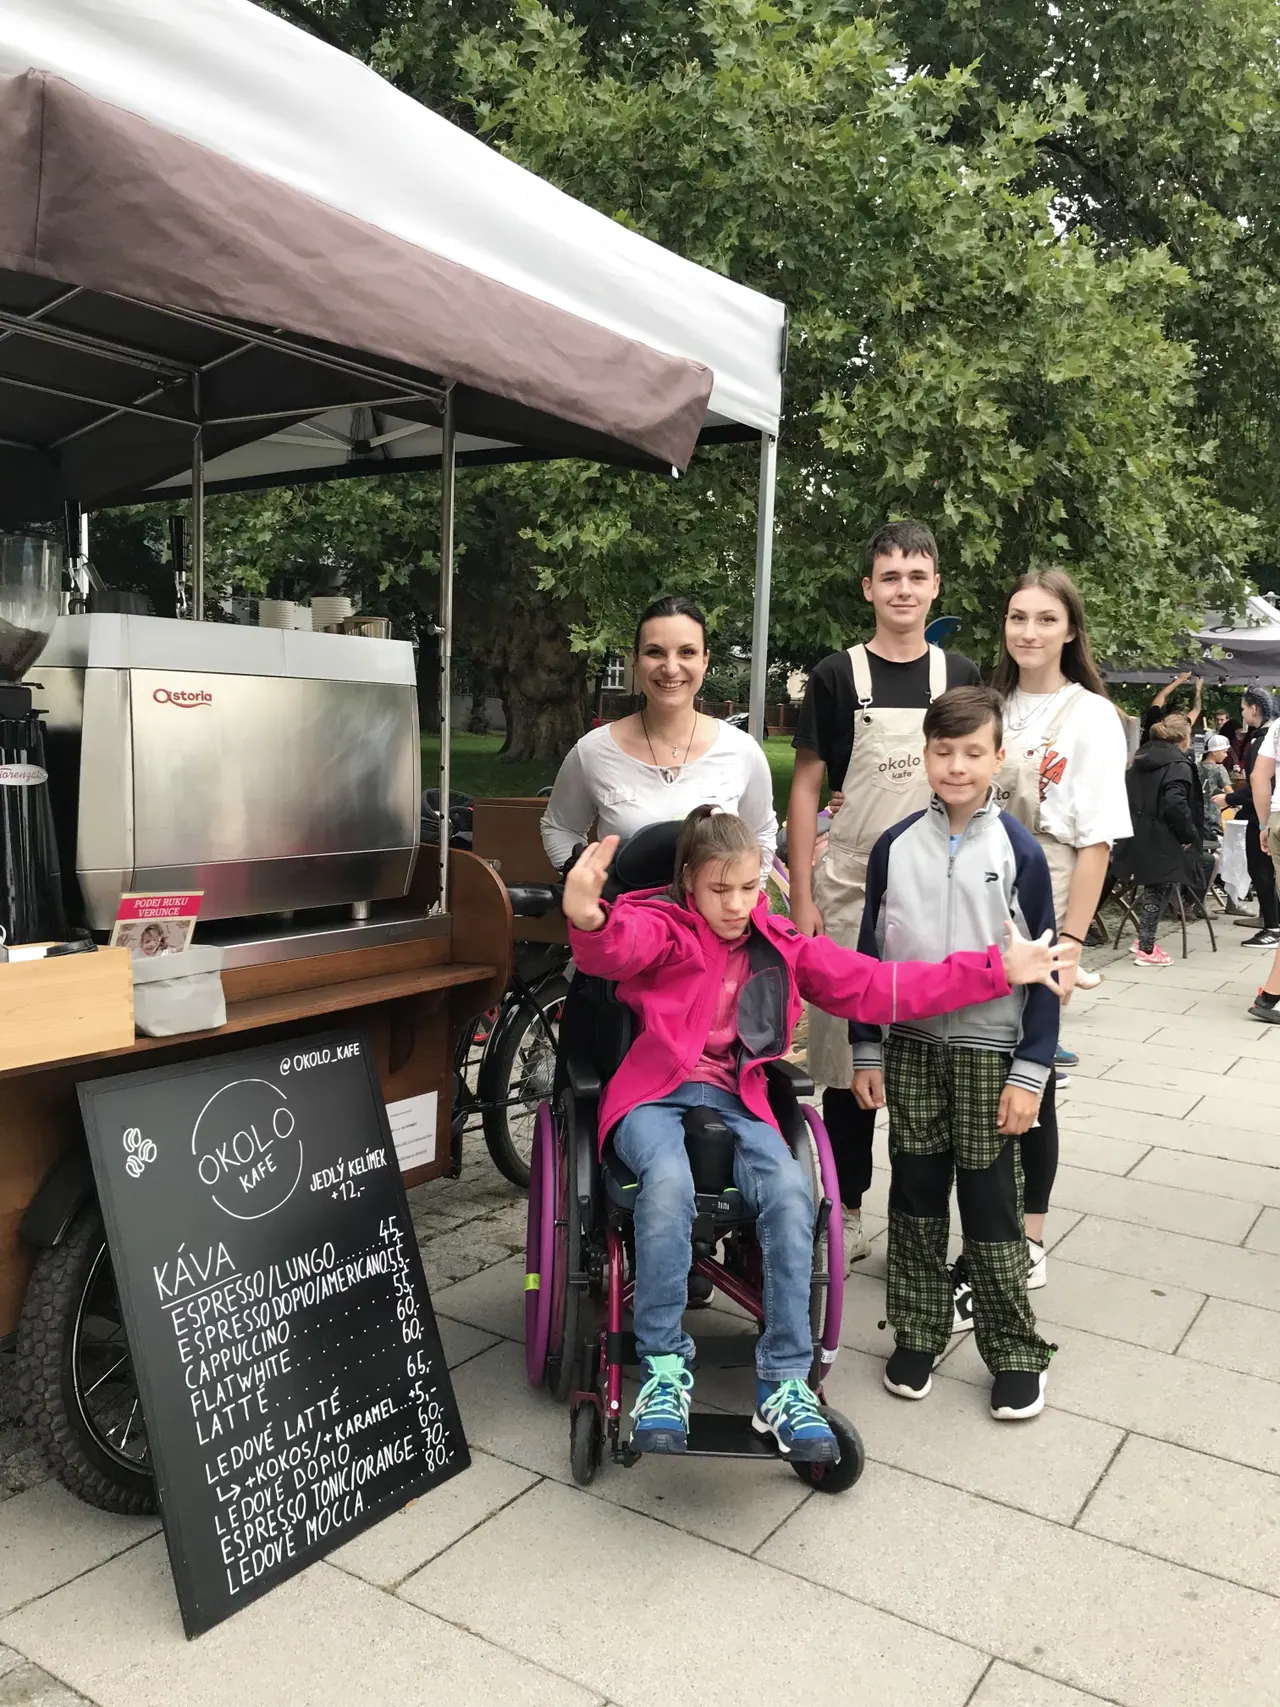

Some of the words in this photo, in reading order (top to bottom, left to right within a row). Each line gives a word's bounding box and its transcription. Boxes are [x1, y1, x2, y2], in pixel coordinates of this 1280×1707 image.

[879, 754, 920, 772] okolo
[892, 770, 911, 780] kafe
[133, 898, 161, 909] PODEJ
[162, 897, 189, 907] RUKU
[138, 907, 180, 918] VERUNCE
[199, 1108, 295, 1184] OKOLO
[239, 1153, 277, 1193] KAFE
[310, 1156, 345, 1192] JEDLÝ
[347, 1147, 388, 1178] KELÍMEK
[153, 1241, 236, 1301] KÁVA
[177, 1303, 270, 1364] ESPRESSO
[185, 1320, 290, 1390] CAPPUCCINO
[195, 1382, 269, 1446] LATTÉ
[205, 1421, 275, 1485] LEDOVÉ
[284, 1386, 341, 1441] LATTÉ
[215, 1476, 285, 1536] LEDOVÉ
[294, 1443, 350, 1490] DOPIO
[220, 1493, 307, 1565] ESPRESSO
[310, 1434, 415, 1510] TONIC/ORANGE
[227, 1526, 296, 1595] LEDOVÉ
[306, 1490, 364, 1546] MOCCA
